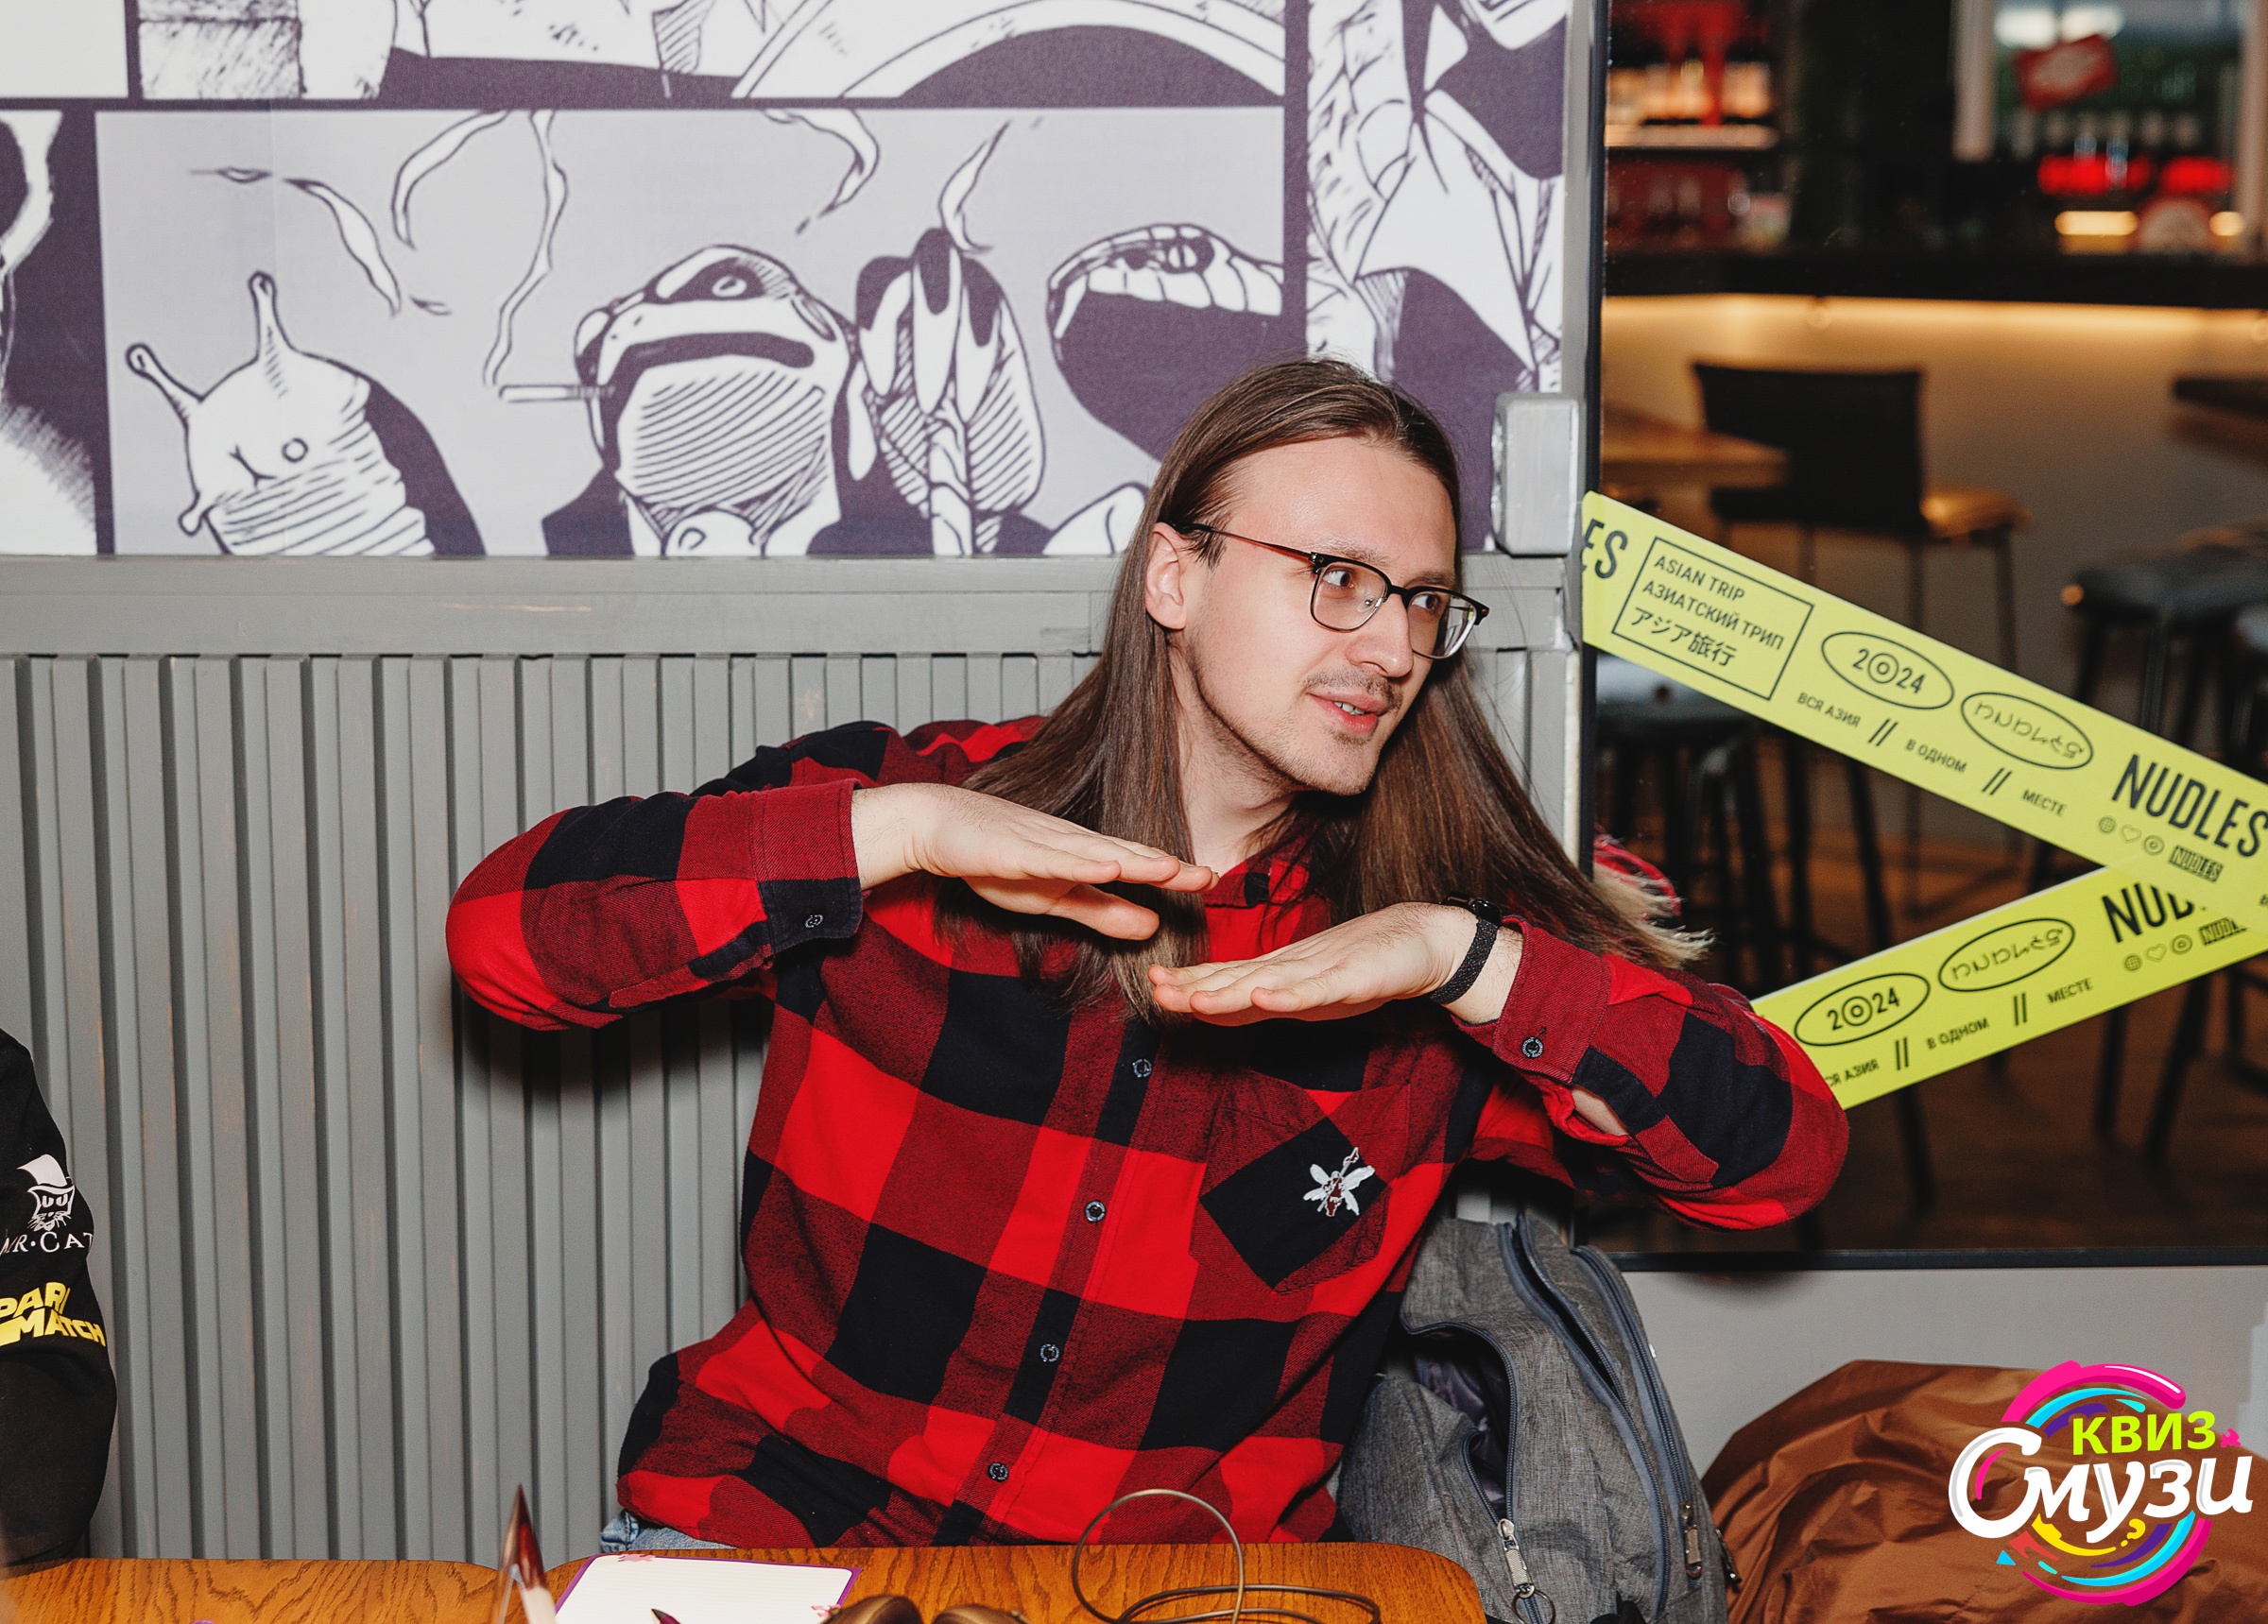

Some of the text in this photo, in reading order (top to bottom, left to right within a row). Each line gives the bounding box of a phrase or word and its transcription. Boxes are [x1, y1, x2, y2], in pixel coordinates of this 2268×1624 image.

[1654, 555, 1745, 602] ASIAN TRIP
[1631, 607, 1737, 666] アジア旅行
[1642, 580, 1785, 650] АЗИАТСКИЙ ТРИП
[1797, 692, 1824, 712] ВСЯ
[1825, 706, 1862, 727] АЗИЯ
[1904, 738, 1915, 752] В
[1916, 744, 1967, 774] ОДНОМ
[2021, 788, 2068, 817] МЕСТЕ
[2111, 753, 2268, 857] NUDLES
[2102, 882, 2207, 944] NUD
[1845, 1059, 1880, 1081] АЗИЯ
[1927, 1036, 1937, 1050] В
[1938, 1017, 1990, 1044] ОДНОМ
[2047, 977, 2094, 1005] МЕСТЕ
[0, 1308, 106, 1347] MATCH
